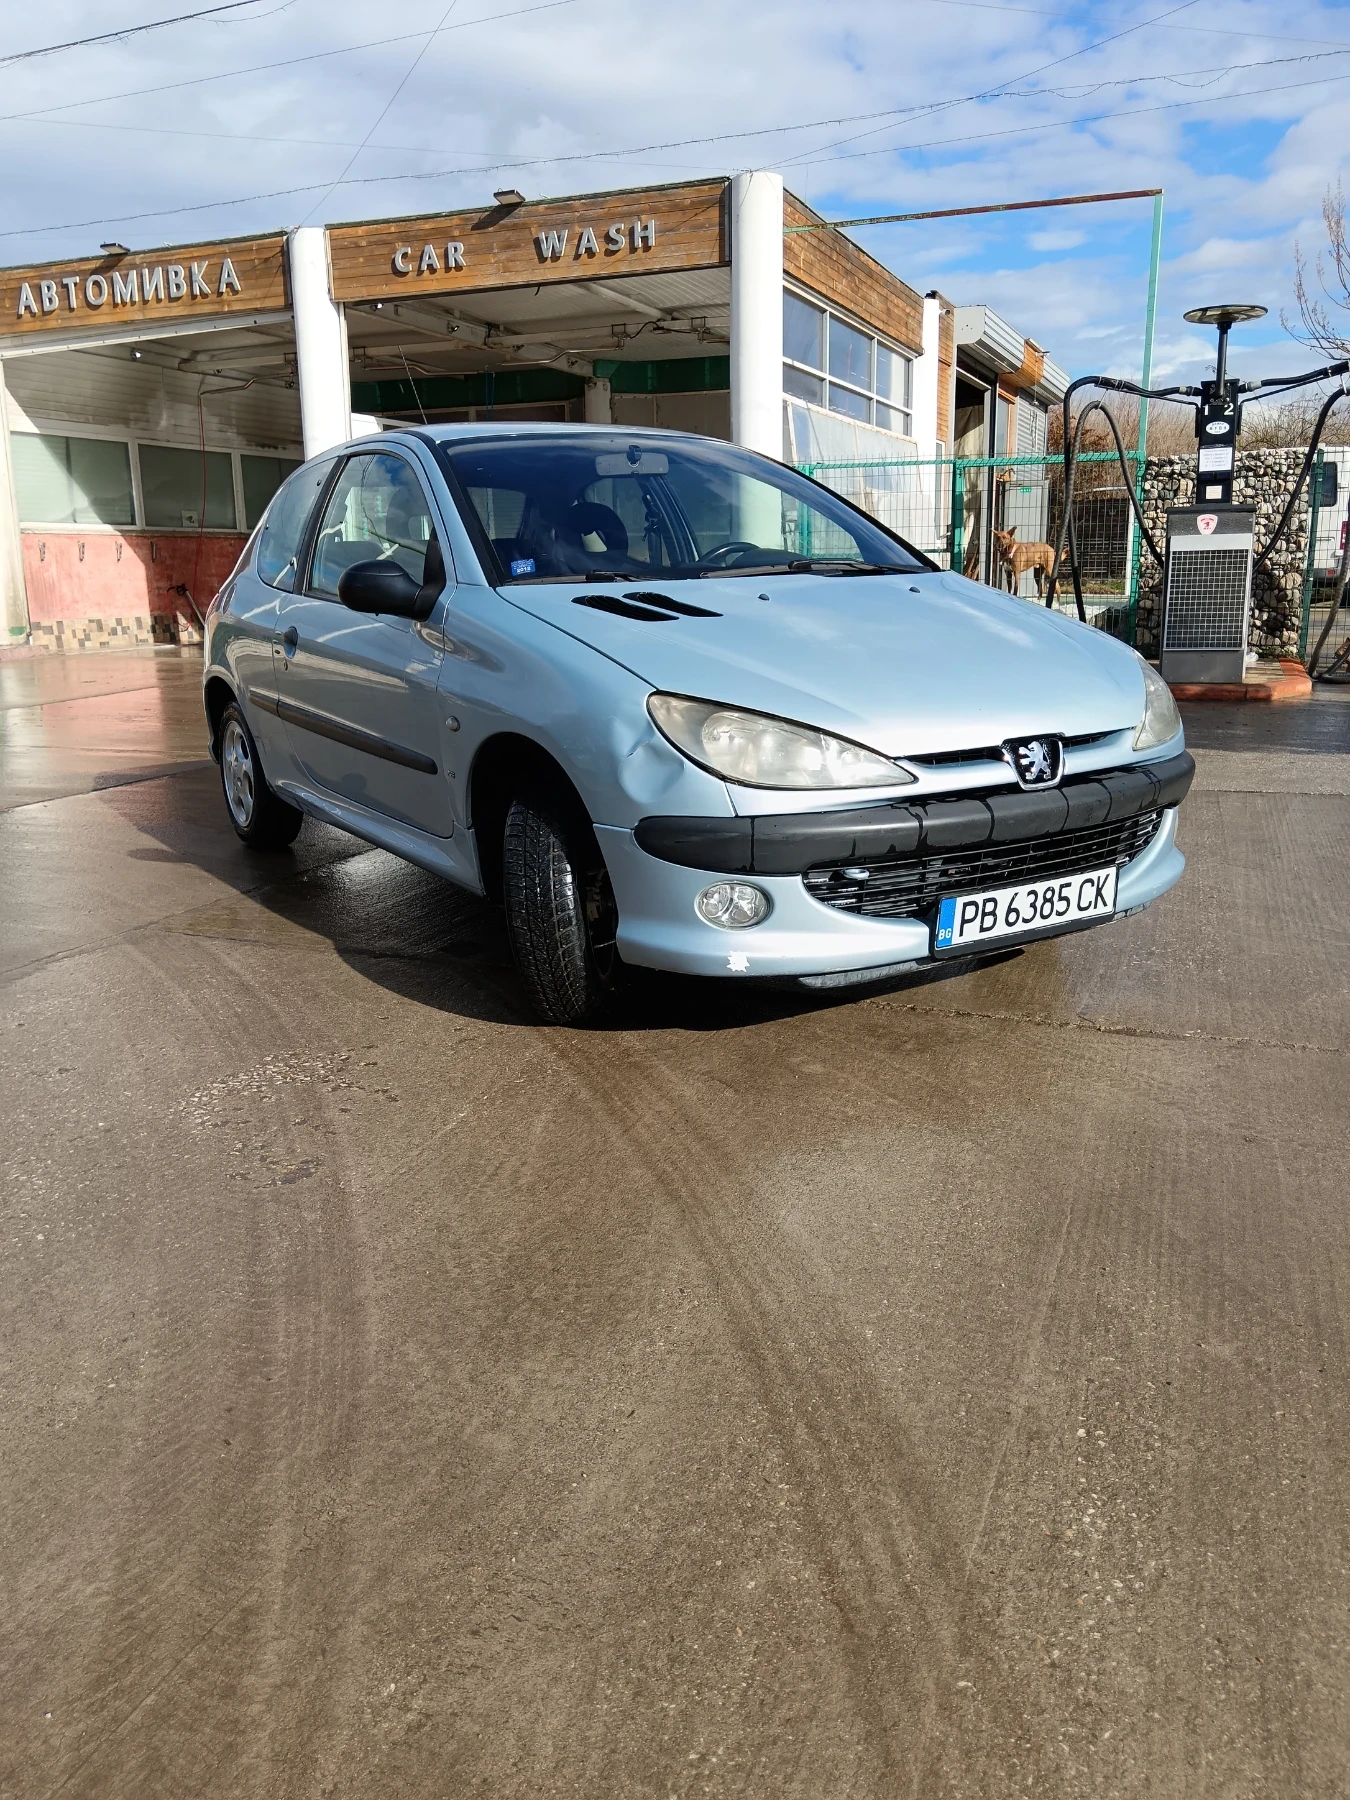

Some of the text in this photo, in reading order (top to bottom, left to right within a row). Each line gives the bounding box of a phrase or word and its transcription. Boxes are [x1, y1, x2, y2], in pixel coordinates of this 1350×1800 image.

[394, 218, 656, 273] CAR WASH
[17, 257, 242, 315] АВТОМИВКА
[1202, 402, 1234, 416] 1 2
[958, 873, 1111, 938] PB 6385 CK
[938, 928, 952, 941] BG
